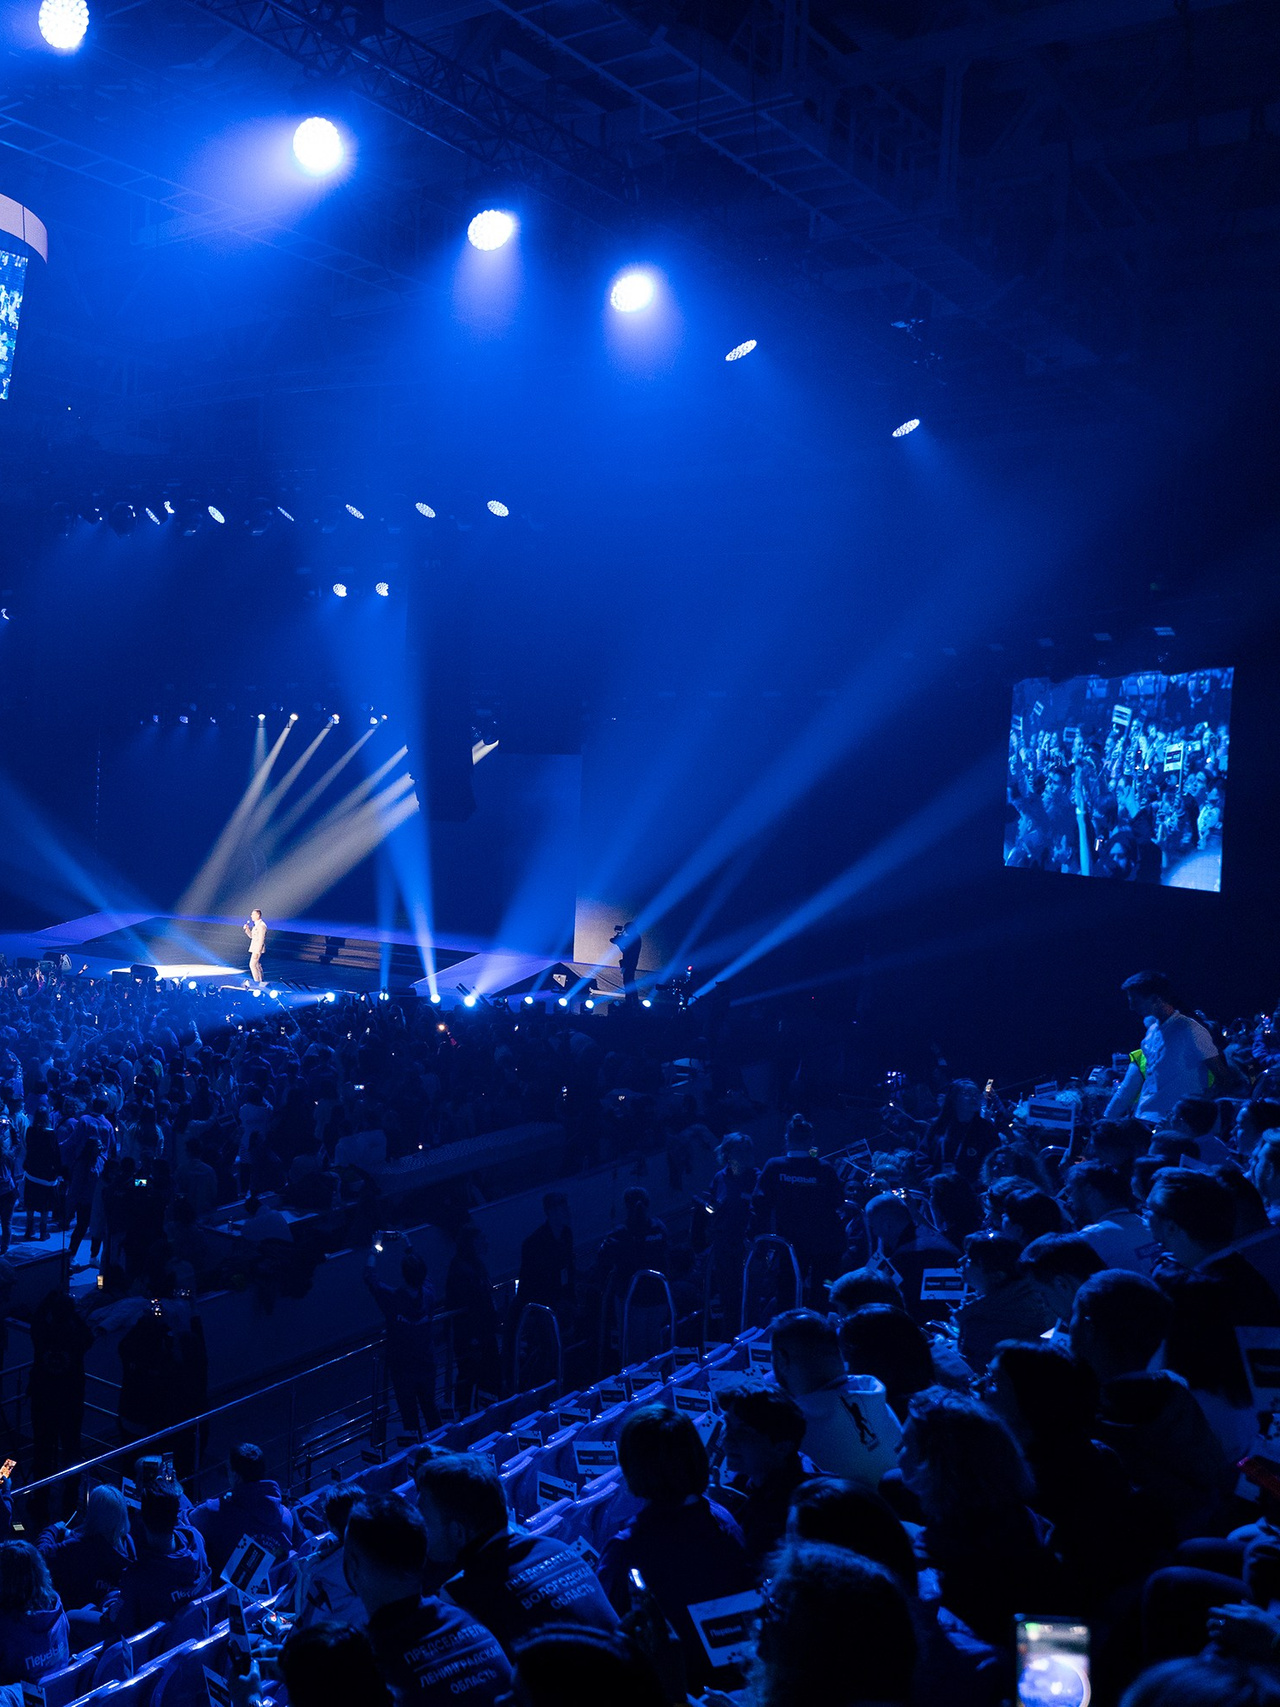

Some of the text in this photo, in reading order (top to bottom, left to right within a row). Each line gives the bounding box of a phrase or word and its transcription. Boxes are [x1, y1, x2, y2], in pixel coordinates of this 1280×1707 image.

[779, 1173, 817, 1185] Первые
[550, 1583, 596, 1610] ОБЛАСТЬ
[450, 1668, 497, 1695] ОБЛАСТЬ
